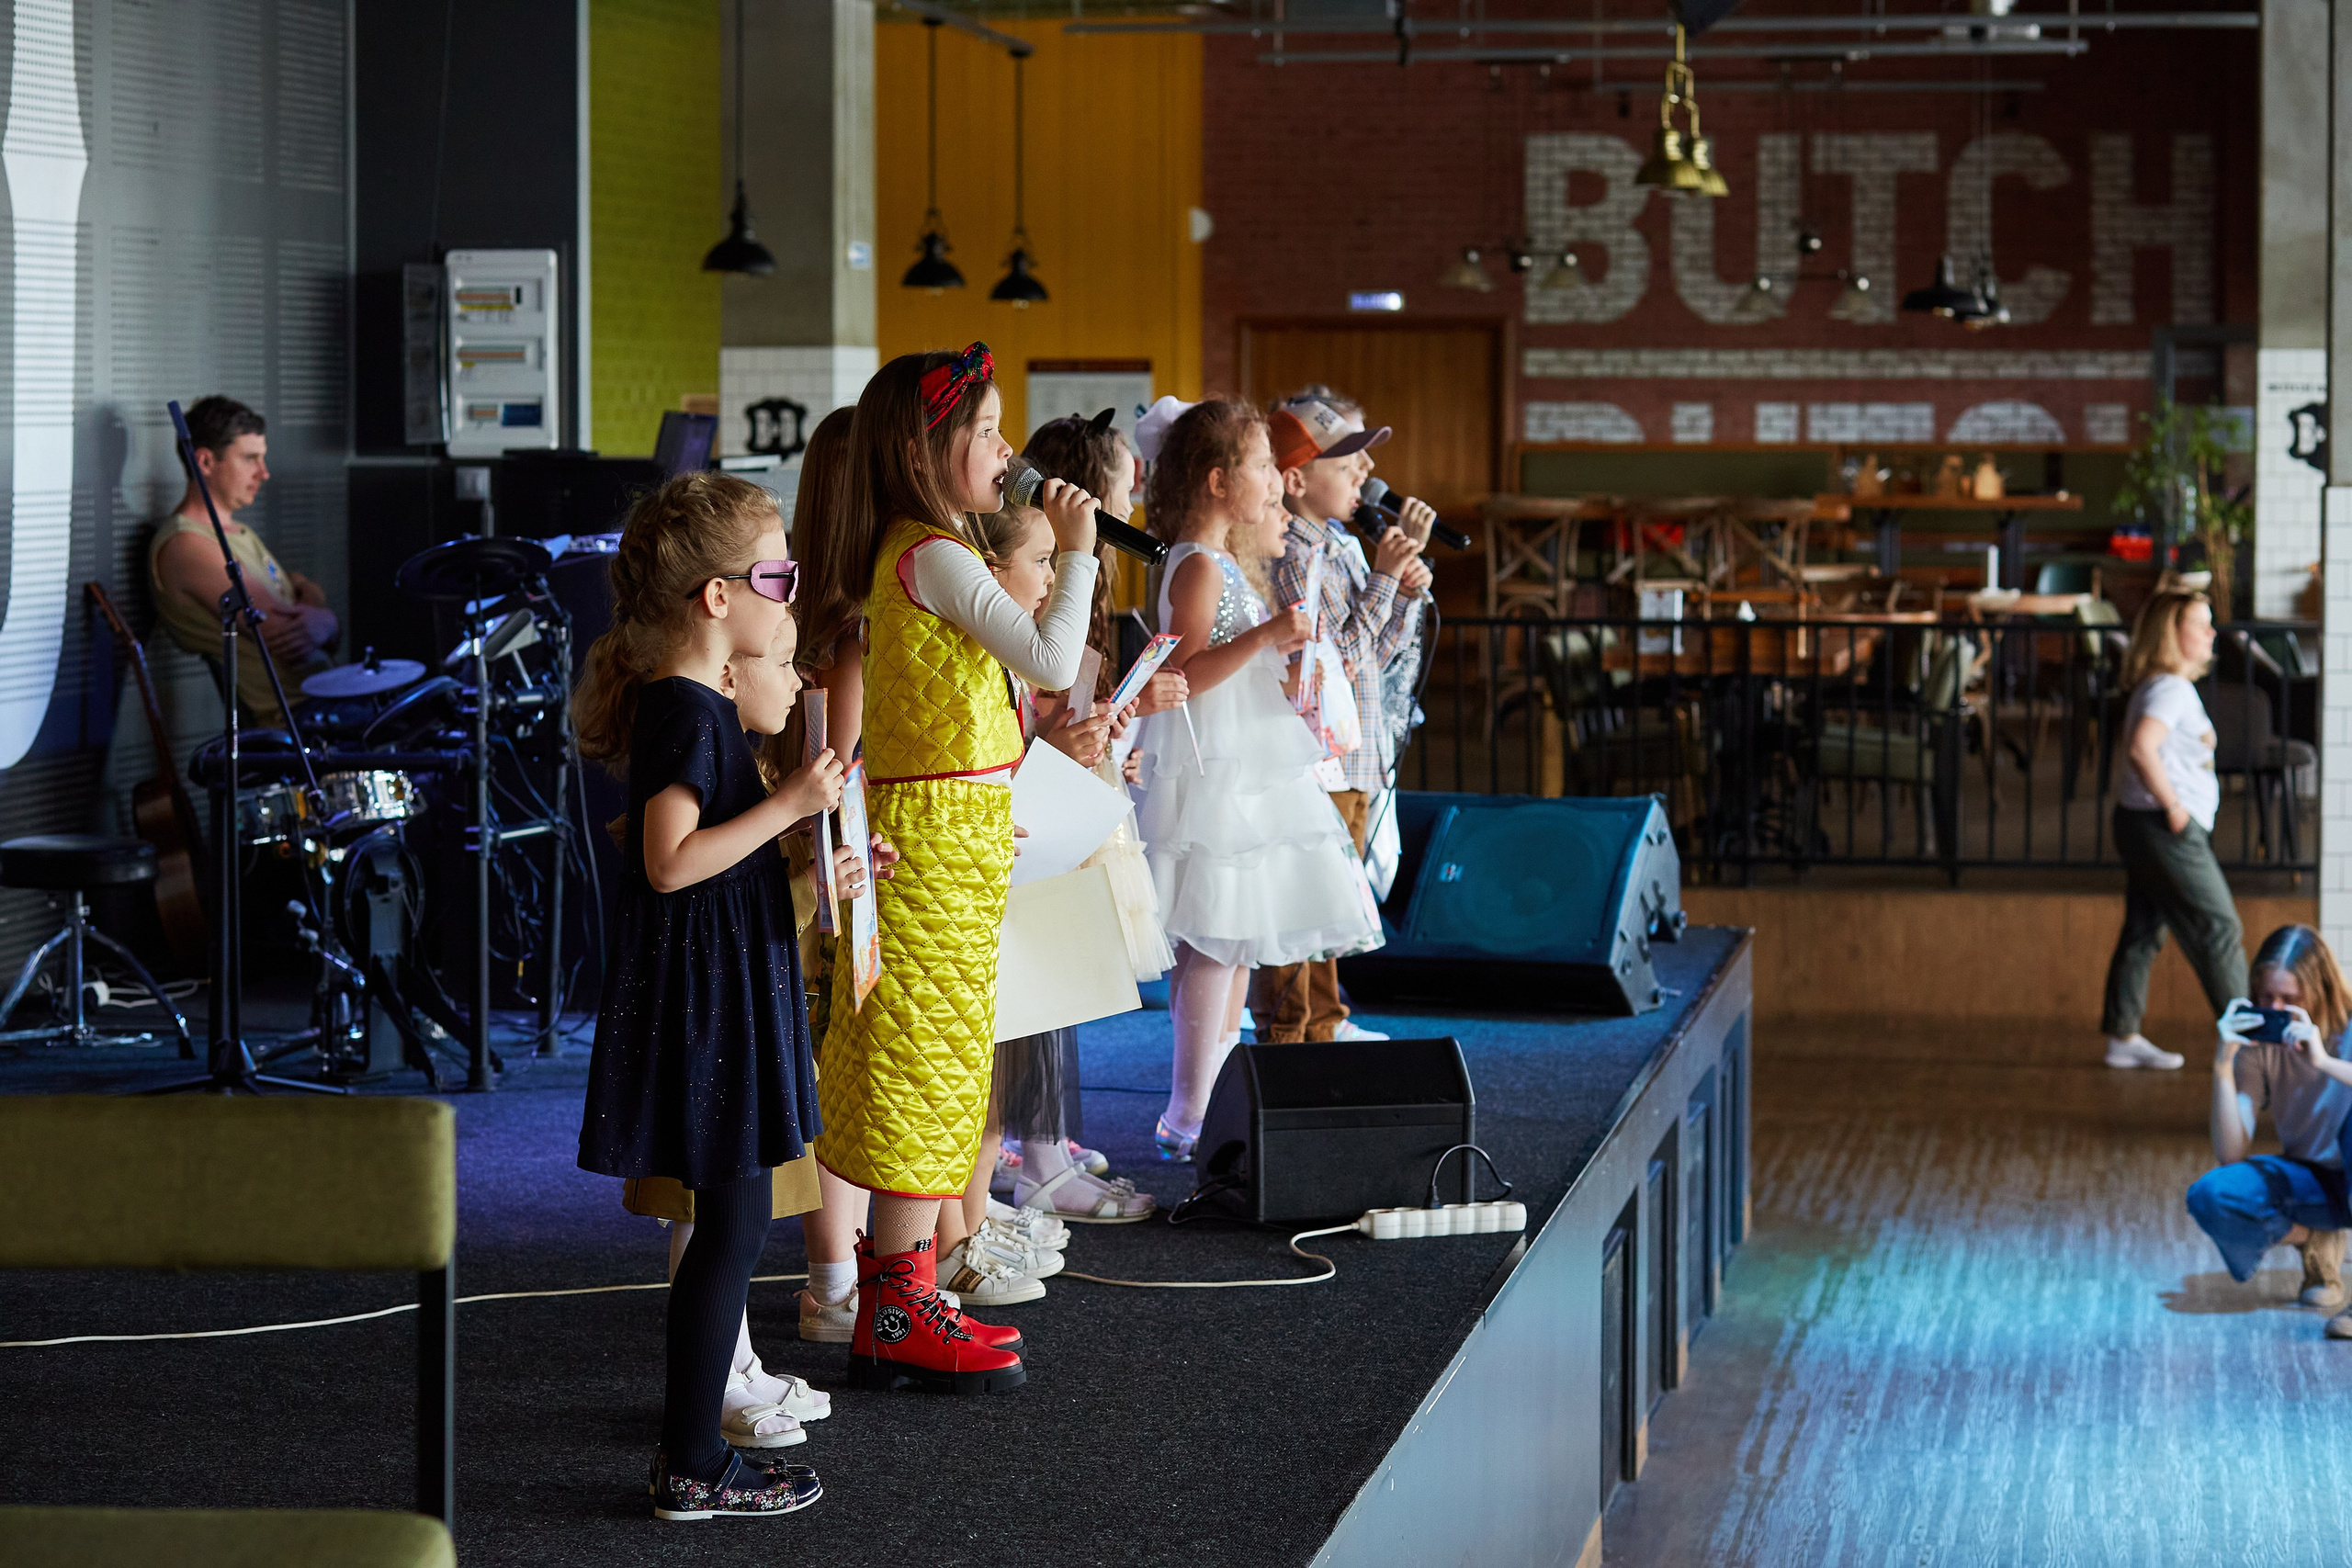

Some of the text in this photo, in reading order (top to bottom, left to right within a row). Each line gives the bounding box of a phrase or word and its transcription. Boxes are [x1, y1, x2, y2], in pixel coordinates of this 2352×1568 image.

[1525, 131, 2215, 325] BUTCH
[876, 1308, 905, 1332] EXCLUSIVE
[891, 1327, 906, 1338] 1991
